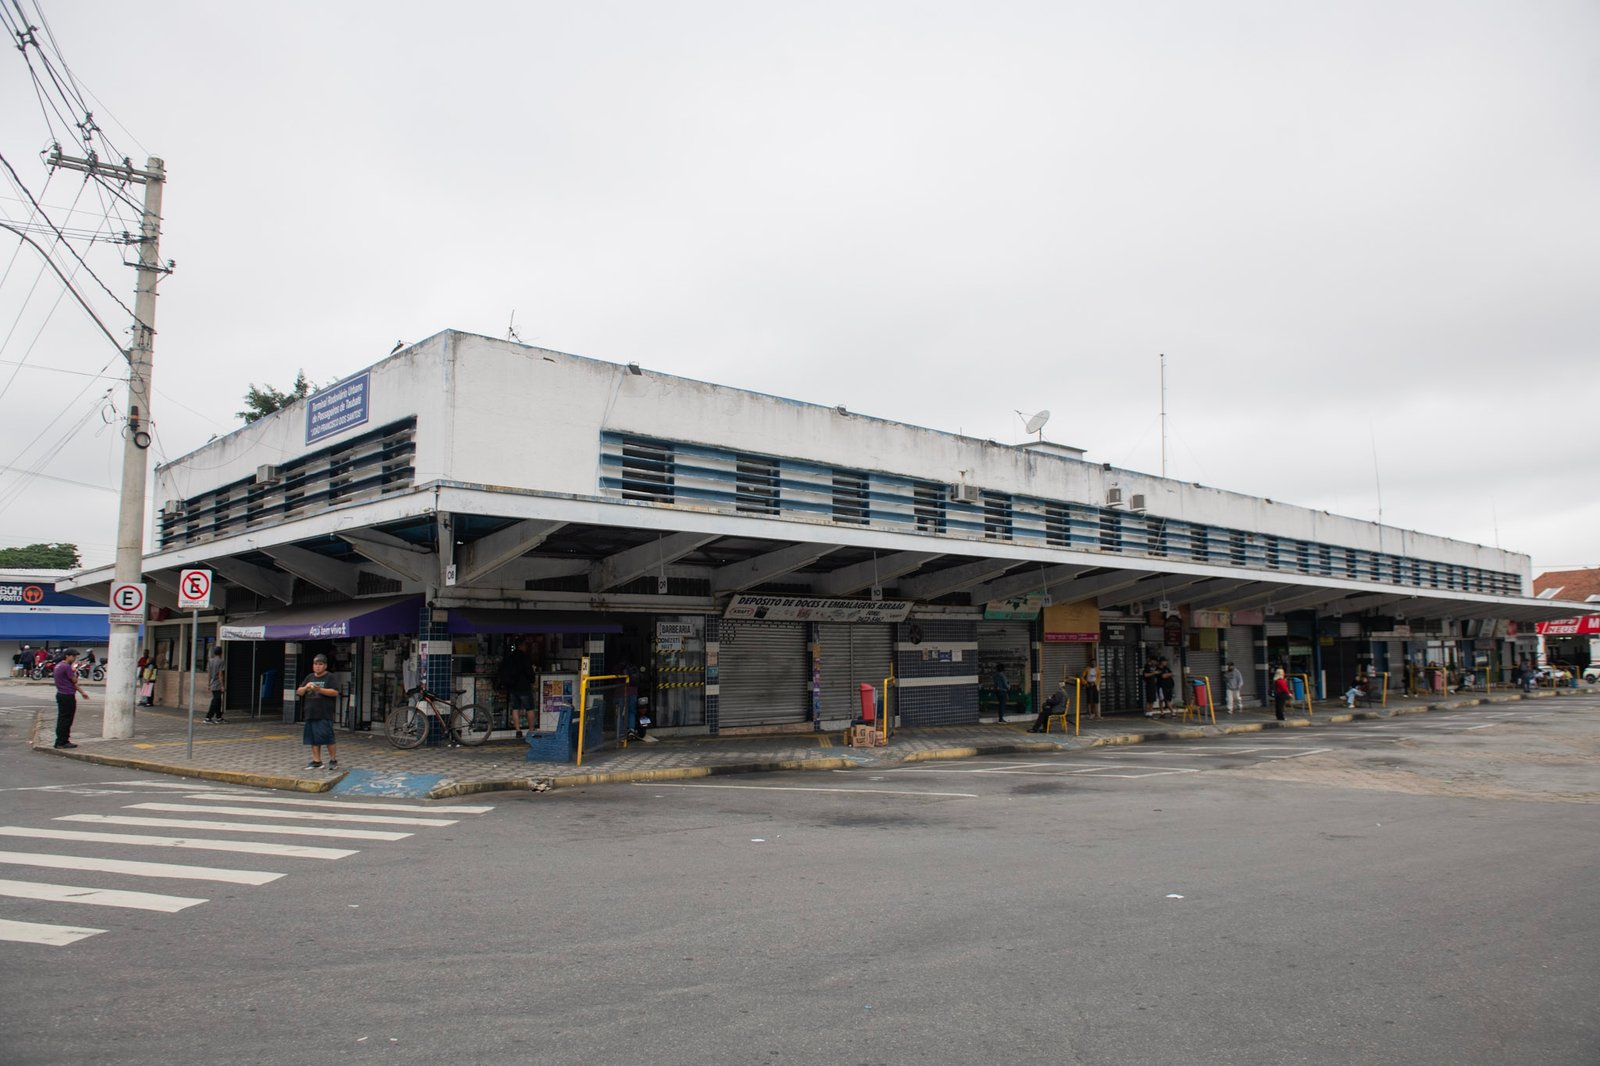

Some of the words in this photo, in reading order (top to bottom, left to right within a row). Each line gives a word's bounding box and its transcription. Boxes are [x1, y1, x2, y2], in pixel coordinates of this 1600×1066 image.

[190, 578, 200, 593] E
[0, 586, 22, 595] BOM
[123, 591, 133, 606] E
[828, 601, 877, 609] EMBALAGENS
[662, 625, 691, 633] BARBEARIA
